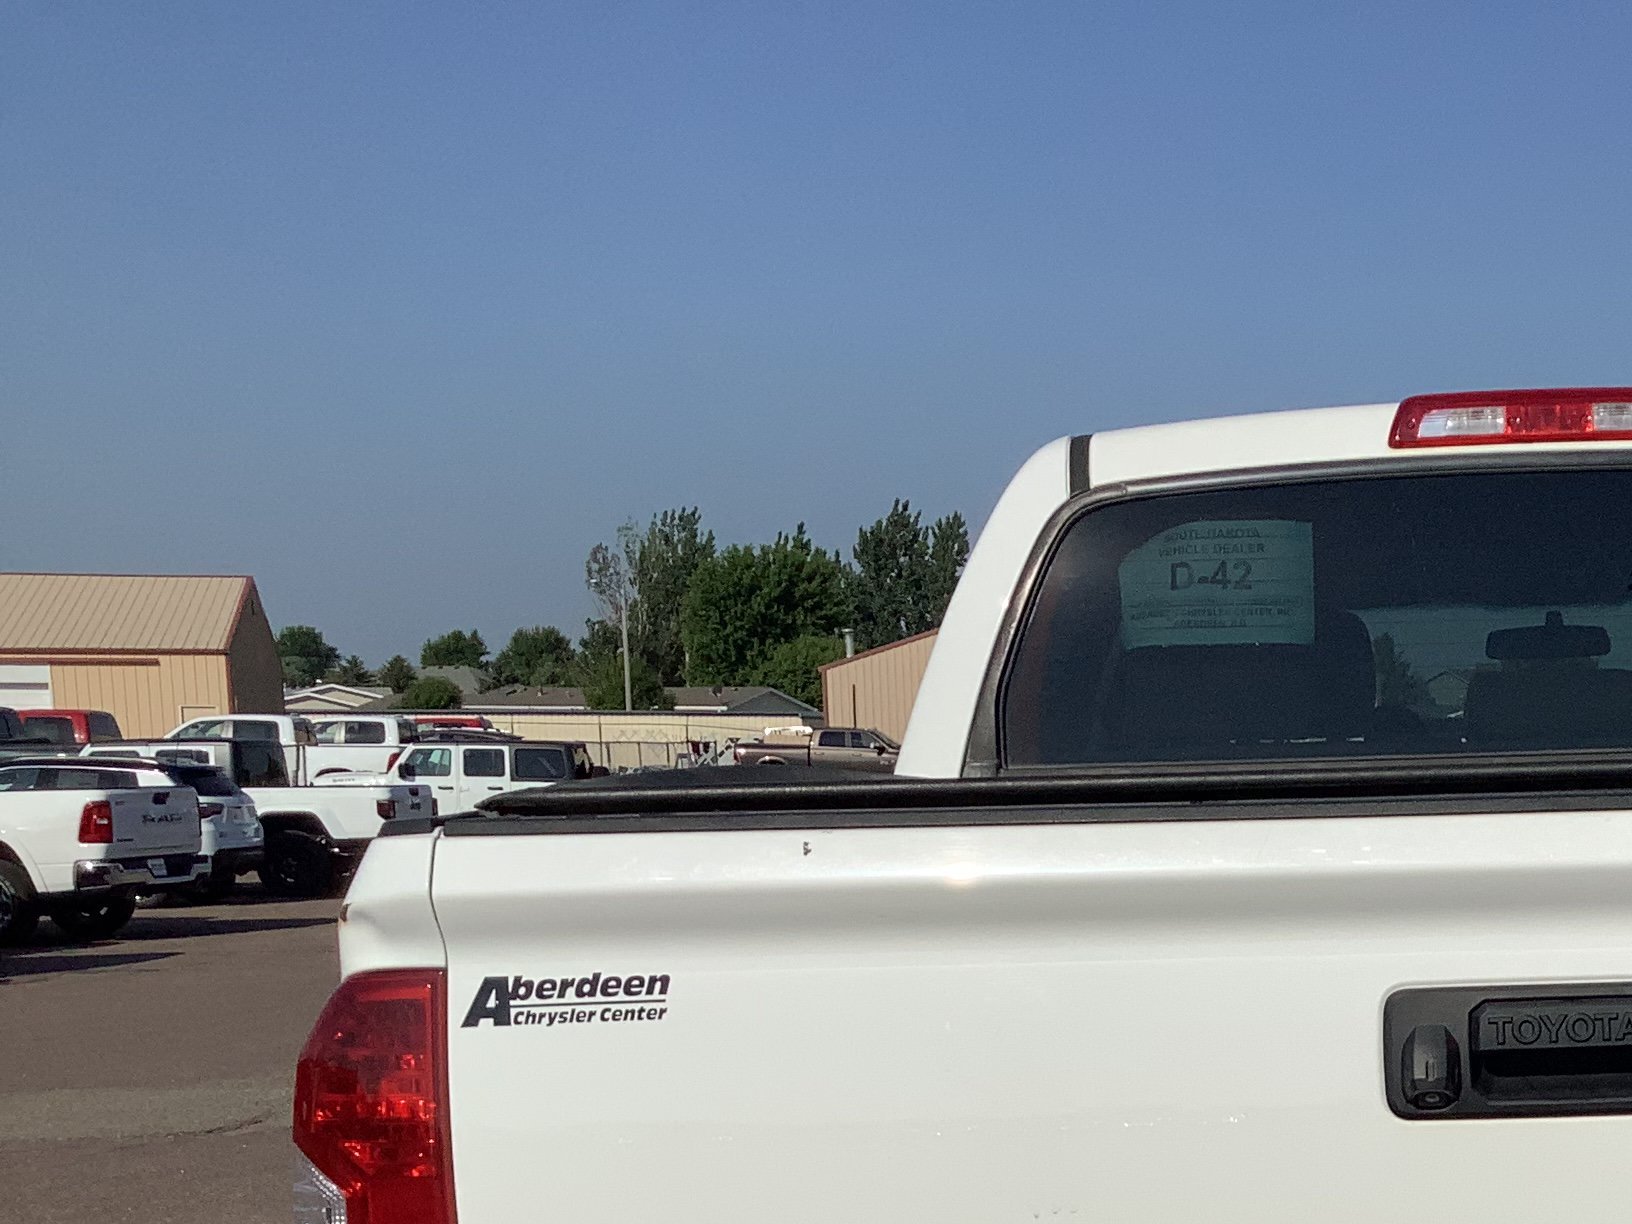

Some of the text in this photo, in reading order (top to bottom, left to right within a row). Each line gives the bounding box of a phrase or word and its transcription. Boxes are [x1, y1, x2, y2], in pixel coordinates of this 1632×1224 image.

[1212, 542, 1266, 554] DEALER
[1169, 559, 1253, 591] D-42
[461, 972, 671, 1028] Aberdeen
[512, 1006, 668, 1026] Chrysler Center
